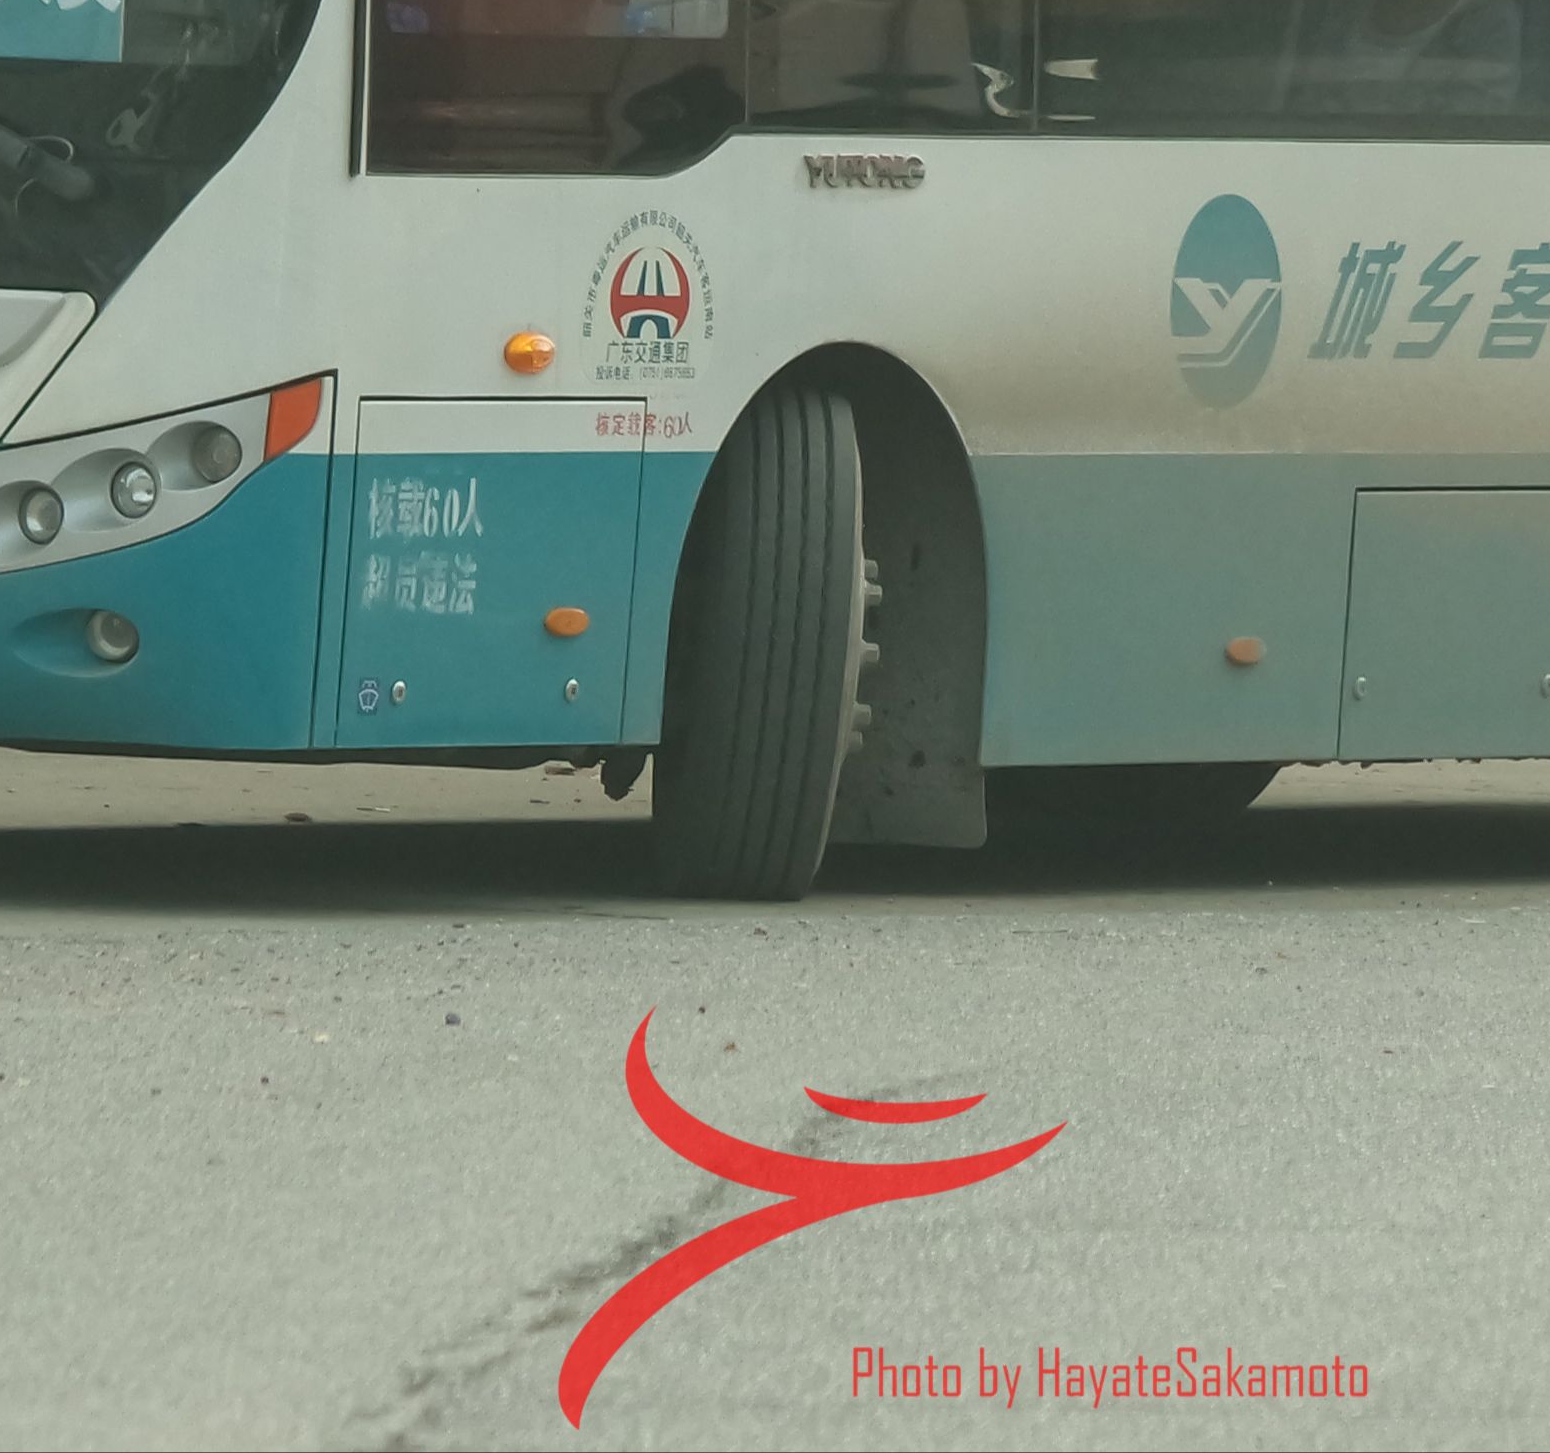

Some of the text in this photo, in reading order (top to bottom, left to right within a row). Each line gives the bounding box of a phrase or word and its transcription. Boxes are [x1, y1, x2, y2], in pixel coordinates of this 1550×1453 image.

[803, 154, 925, 189] YUTONG
[605, 340, 690, 364] 广东交通集团
